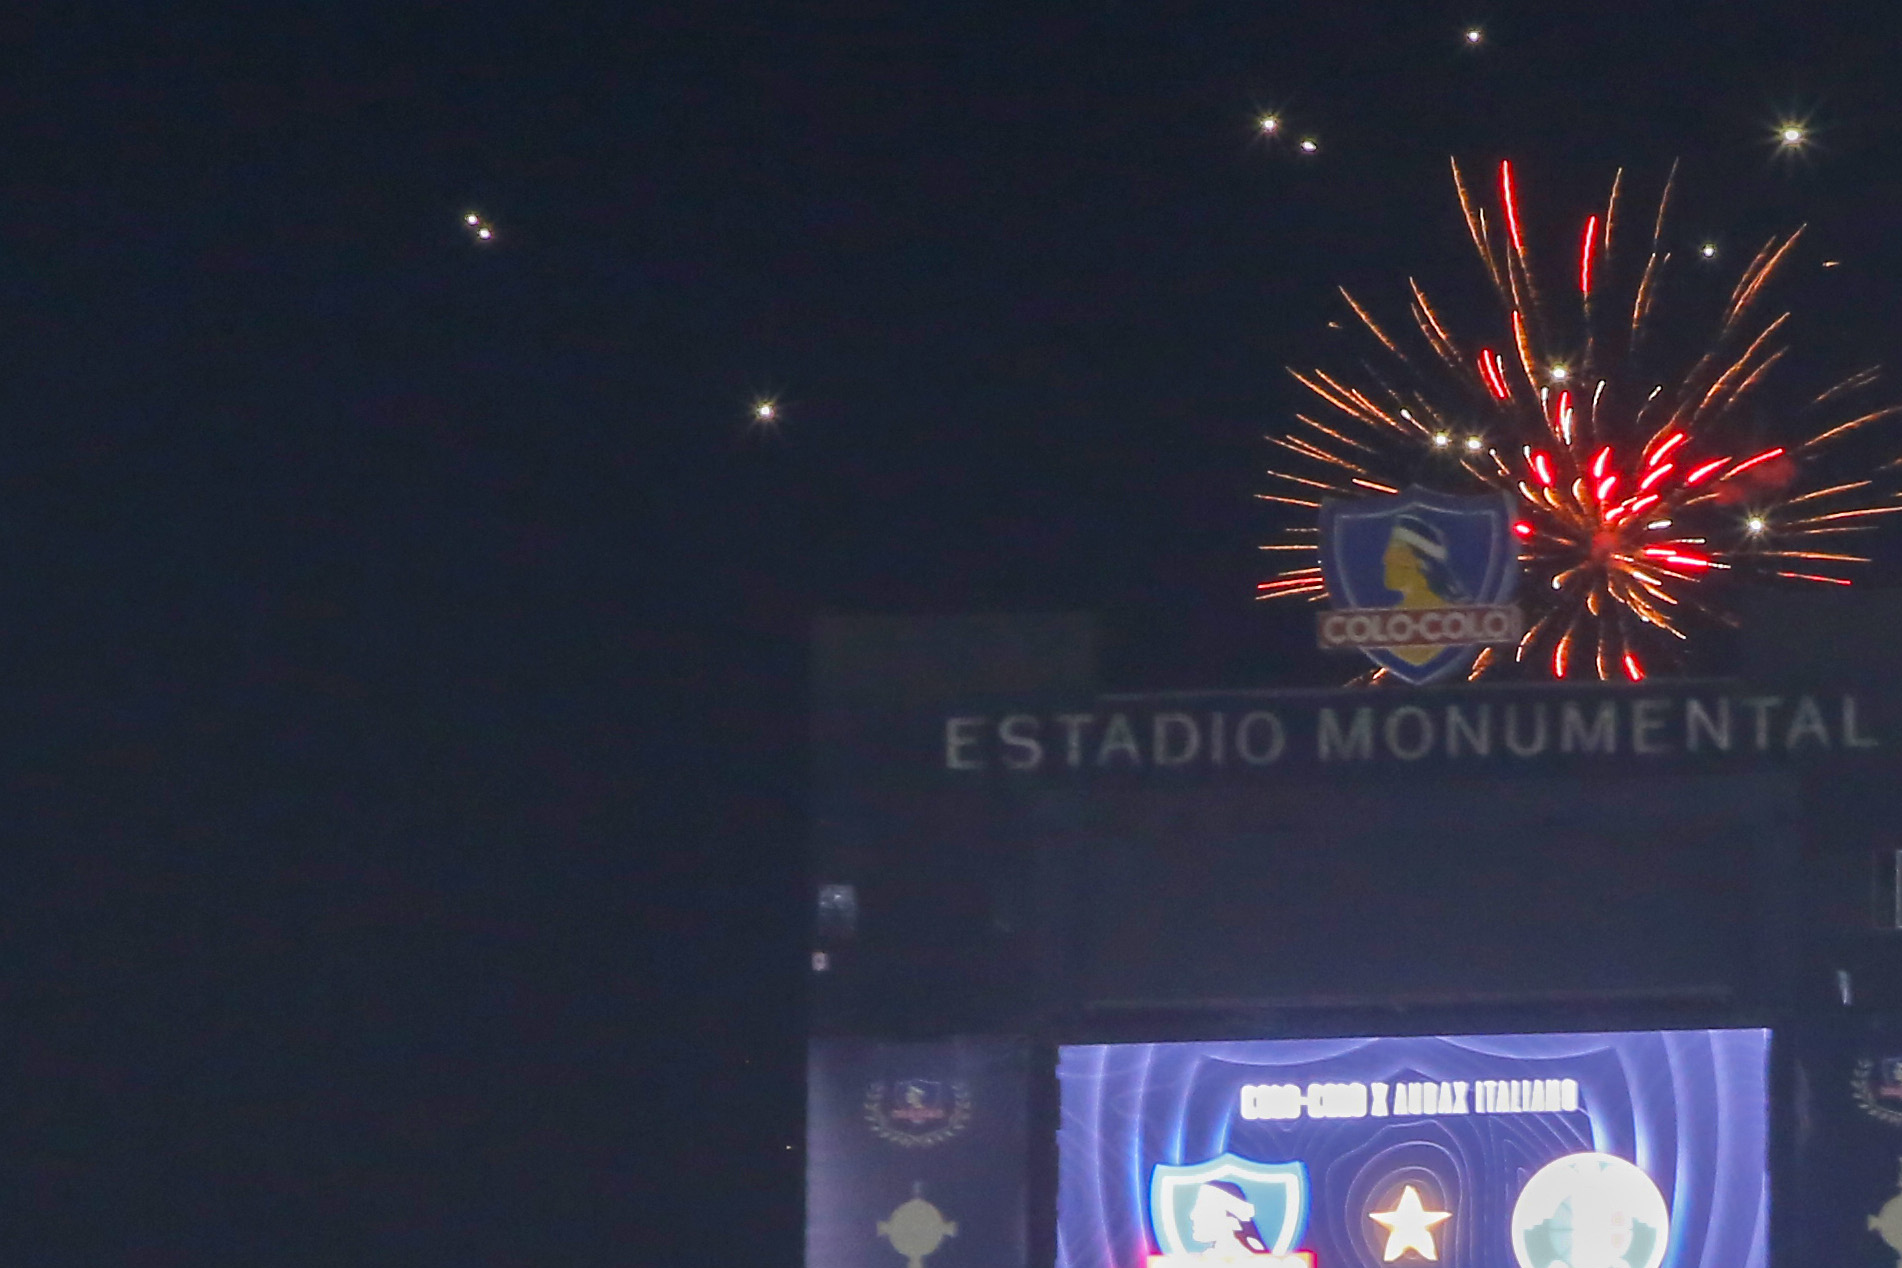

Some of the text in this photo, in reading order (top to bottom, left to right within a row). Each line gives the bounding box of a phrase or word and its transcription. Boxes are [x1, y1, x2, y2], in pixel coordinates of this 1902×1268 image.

[1323, 611, 1509, 644] COLO-COLO
[944, 694, 1880, 772] ESTADIO MONUMENTAL
[1393, 1081, 1469, 1115] AUDAX
[1475, 1078, 1578, 1113] ITALIANO
